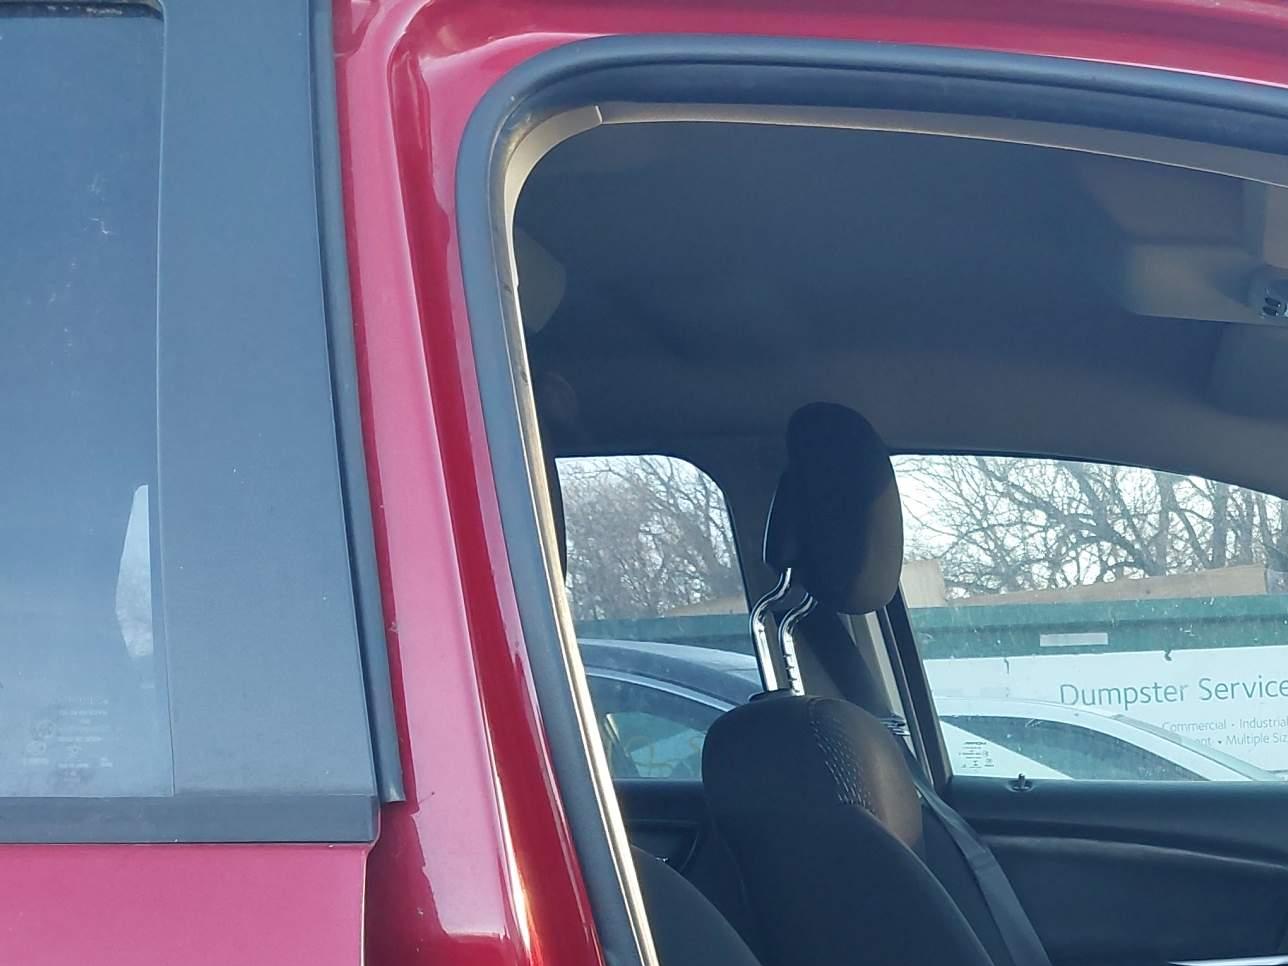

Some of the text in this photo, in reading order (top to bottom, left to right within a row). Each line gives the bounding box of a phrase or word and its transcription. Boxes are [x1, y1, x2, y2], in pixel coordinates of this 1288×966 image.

[1059, 681, 1188, 711] Dumpster
[1161, 716, 1288, 733] Commercial Industrial
[1225, 733, 1270, 747] Multiple
